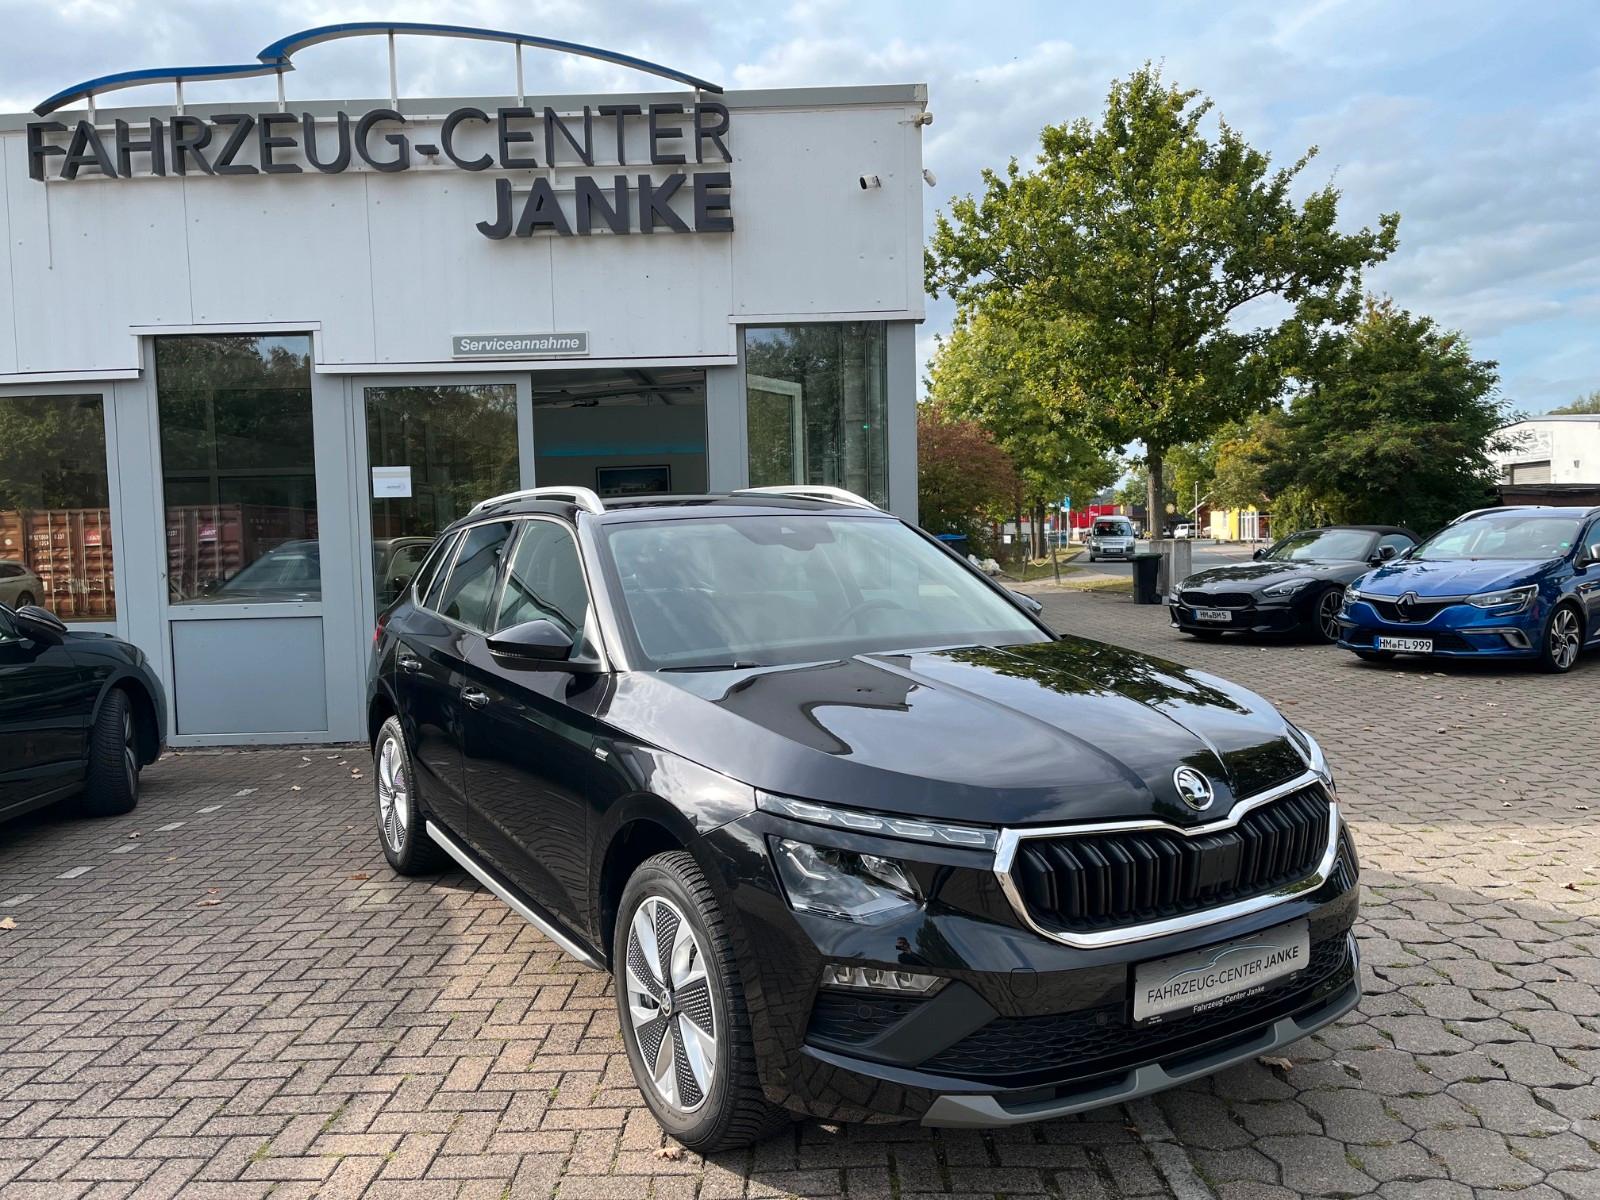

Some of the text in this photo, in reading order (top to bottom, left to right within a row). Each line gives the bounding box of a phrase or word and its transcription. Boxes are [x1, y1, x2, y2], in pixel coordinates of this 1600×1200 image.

[27, 103, 733, 182] FAHRZEUG-CENTER
[476, 172, 735, 240] JANKE
[459, 335, 581, 354] Serviceannahme
[1412, 641, 1431, 650] 999
[1147, 960, 1262, 1003] FAHRZEUG-CENTER
[1264, 946, 1299, 968] JANKE
[1192, 985, 1265, 1013] Fahrzeug-Center Janke
